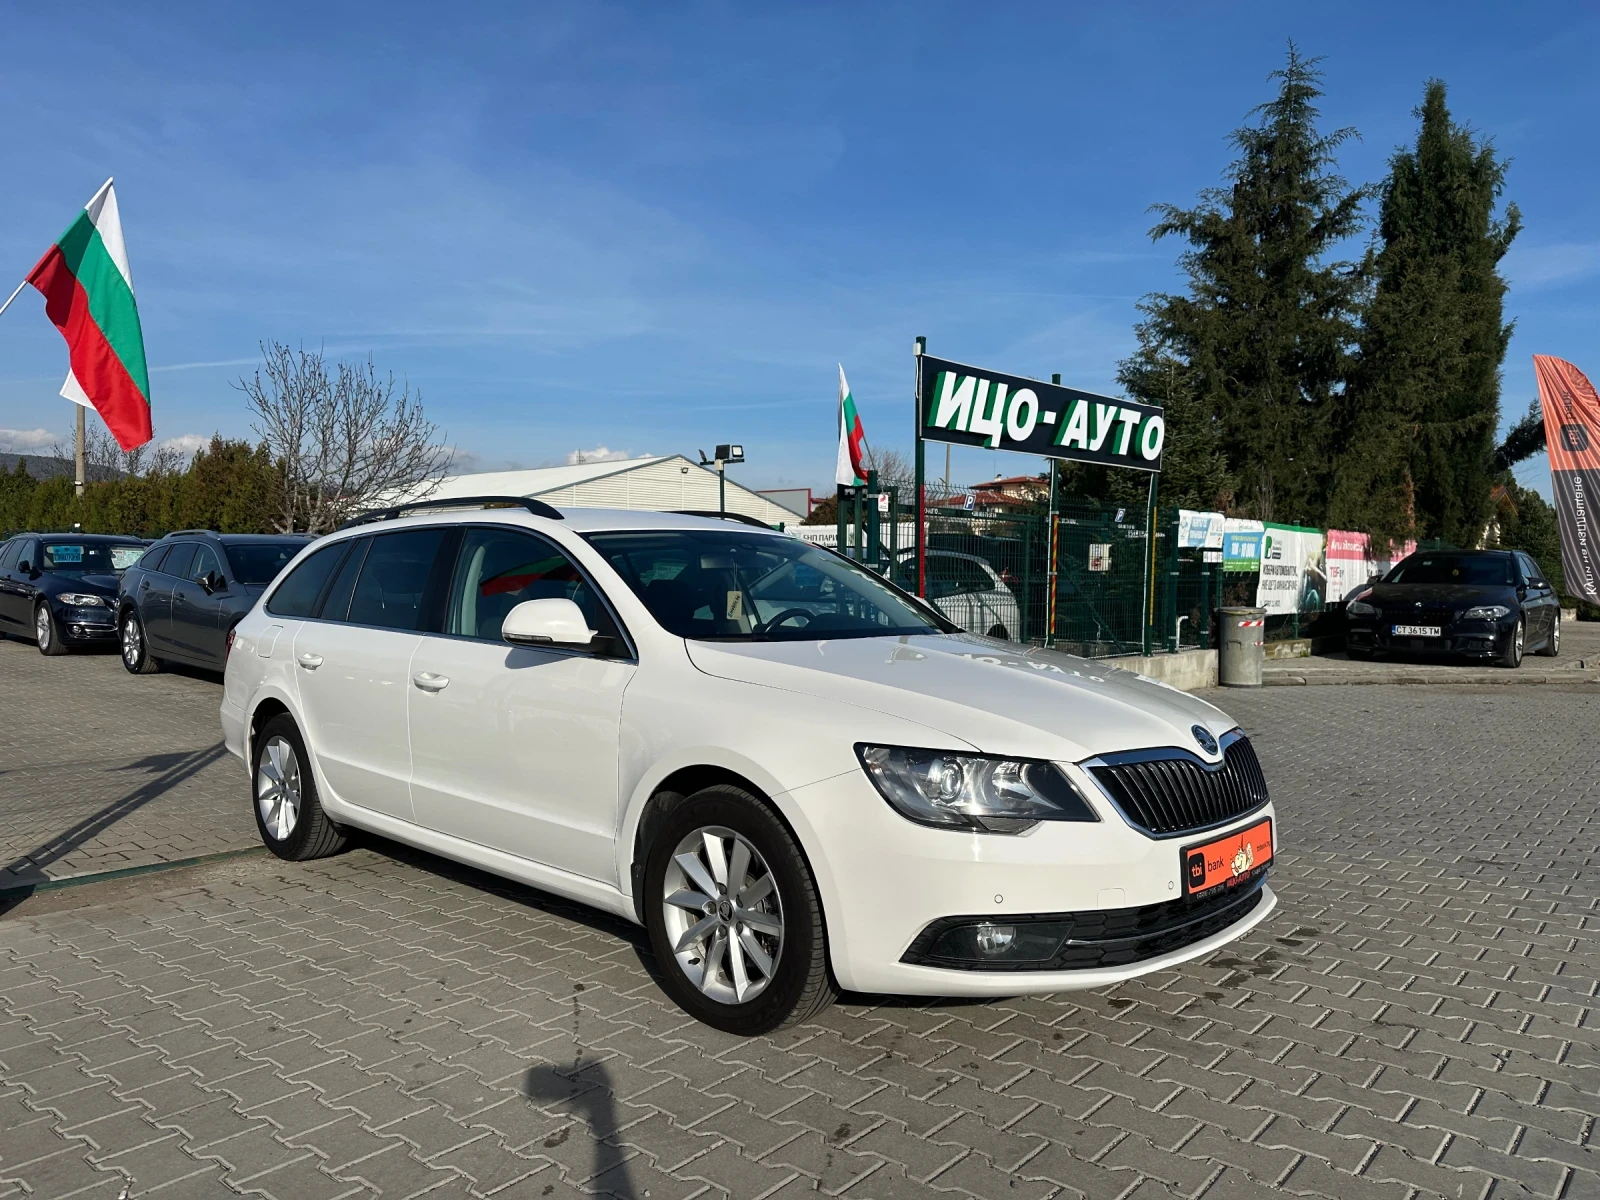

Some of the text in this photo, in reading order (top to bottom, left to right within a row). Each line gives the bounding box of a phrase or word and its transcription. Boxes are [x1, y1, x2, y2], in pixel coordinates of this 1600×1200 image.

[1408, 626, 1428, 635] 3615
[1429, 627, 1440, 636] TM
[1191, 856, 1225, 878] tbi bank
